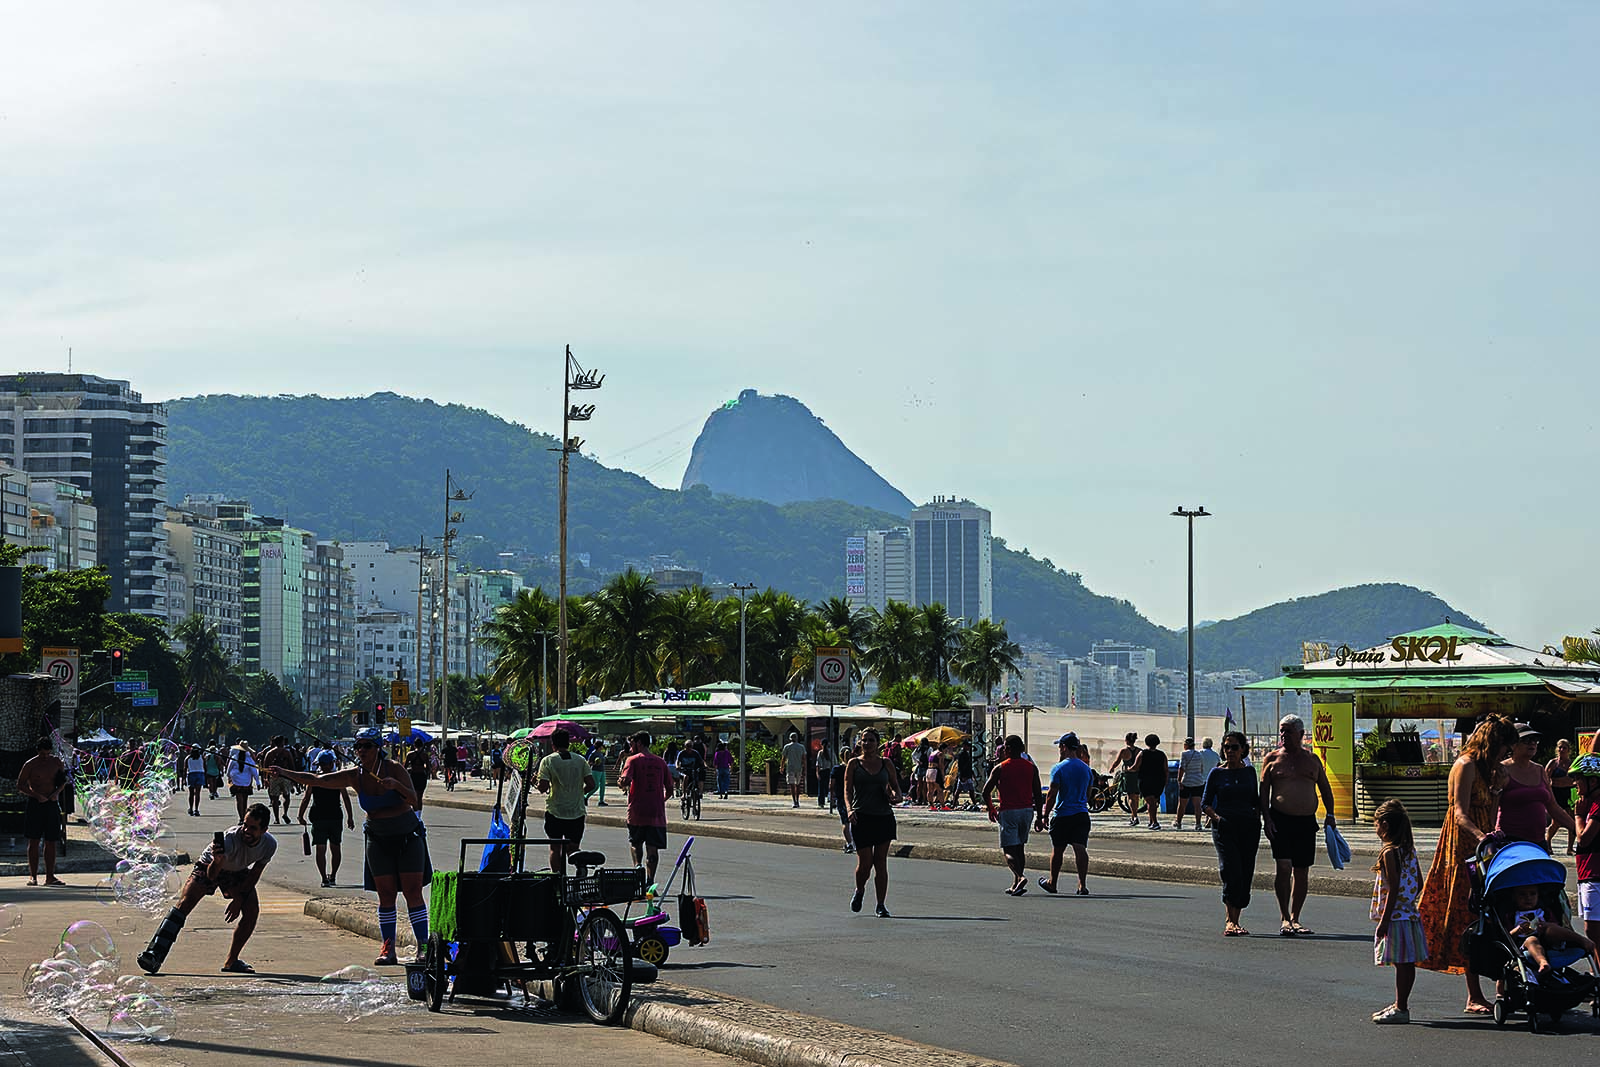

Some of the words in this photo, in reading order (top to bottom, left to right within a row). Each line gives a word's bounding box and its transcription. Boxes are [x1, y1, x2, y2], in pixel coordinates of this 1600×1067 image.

[931, 511, 960, 519] Hilton
[261, 549, 281, 559] ARENA
[847, 555, 864, 564] ZERO
[1336, 644, 1385, 666] Praia
[1390, 636, 1463, 664] SKOL
[53, 665, 68, 679] 70
[825, 663, 840, 673] 70
[661, 689, 711, 703] Destinow
